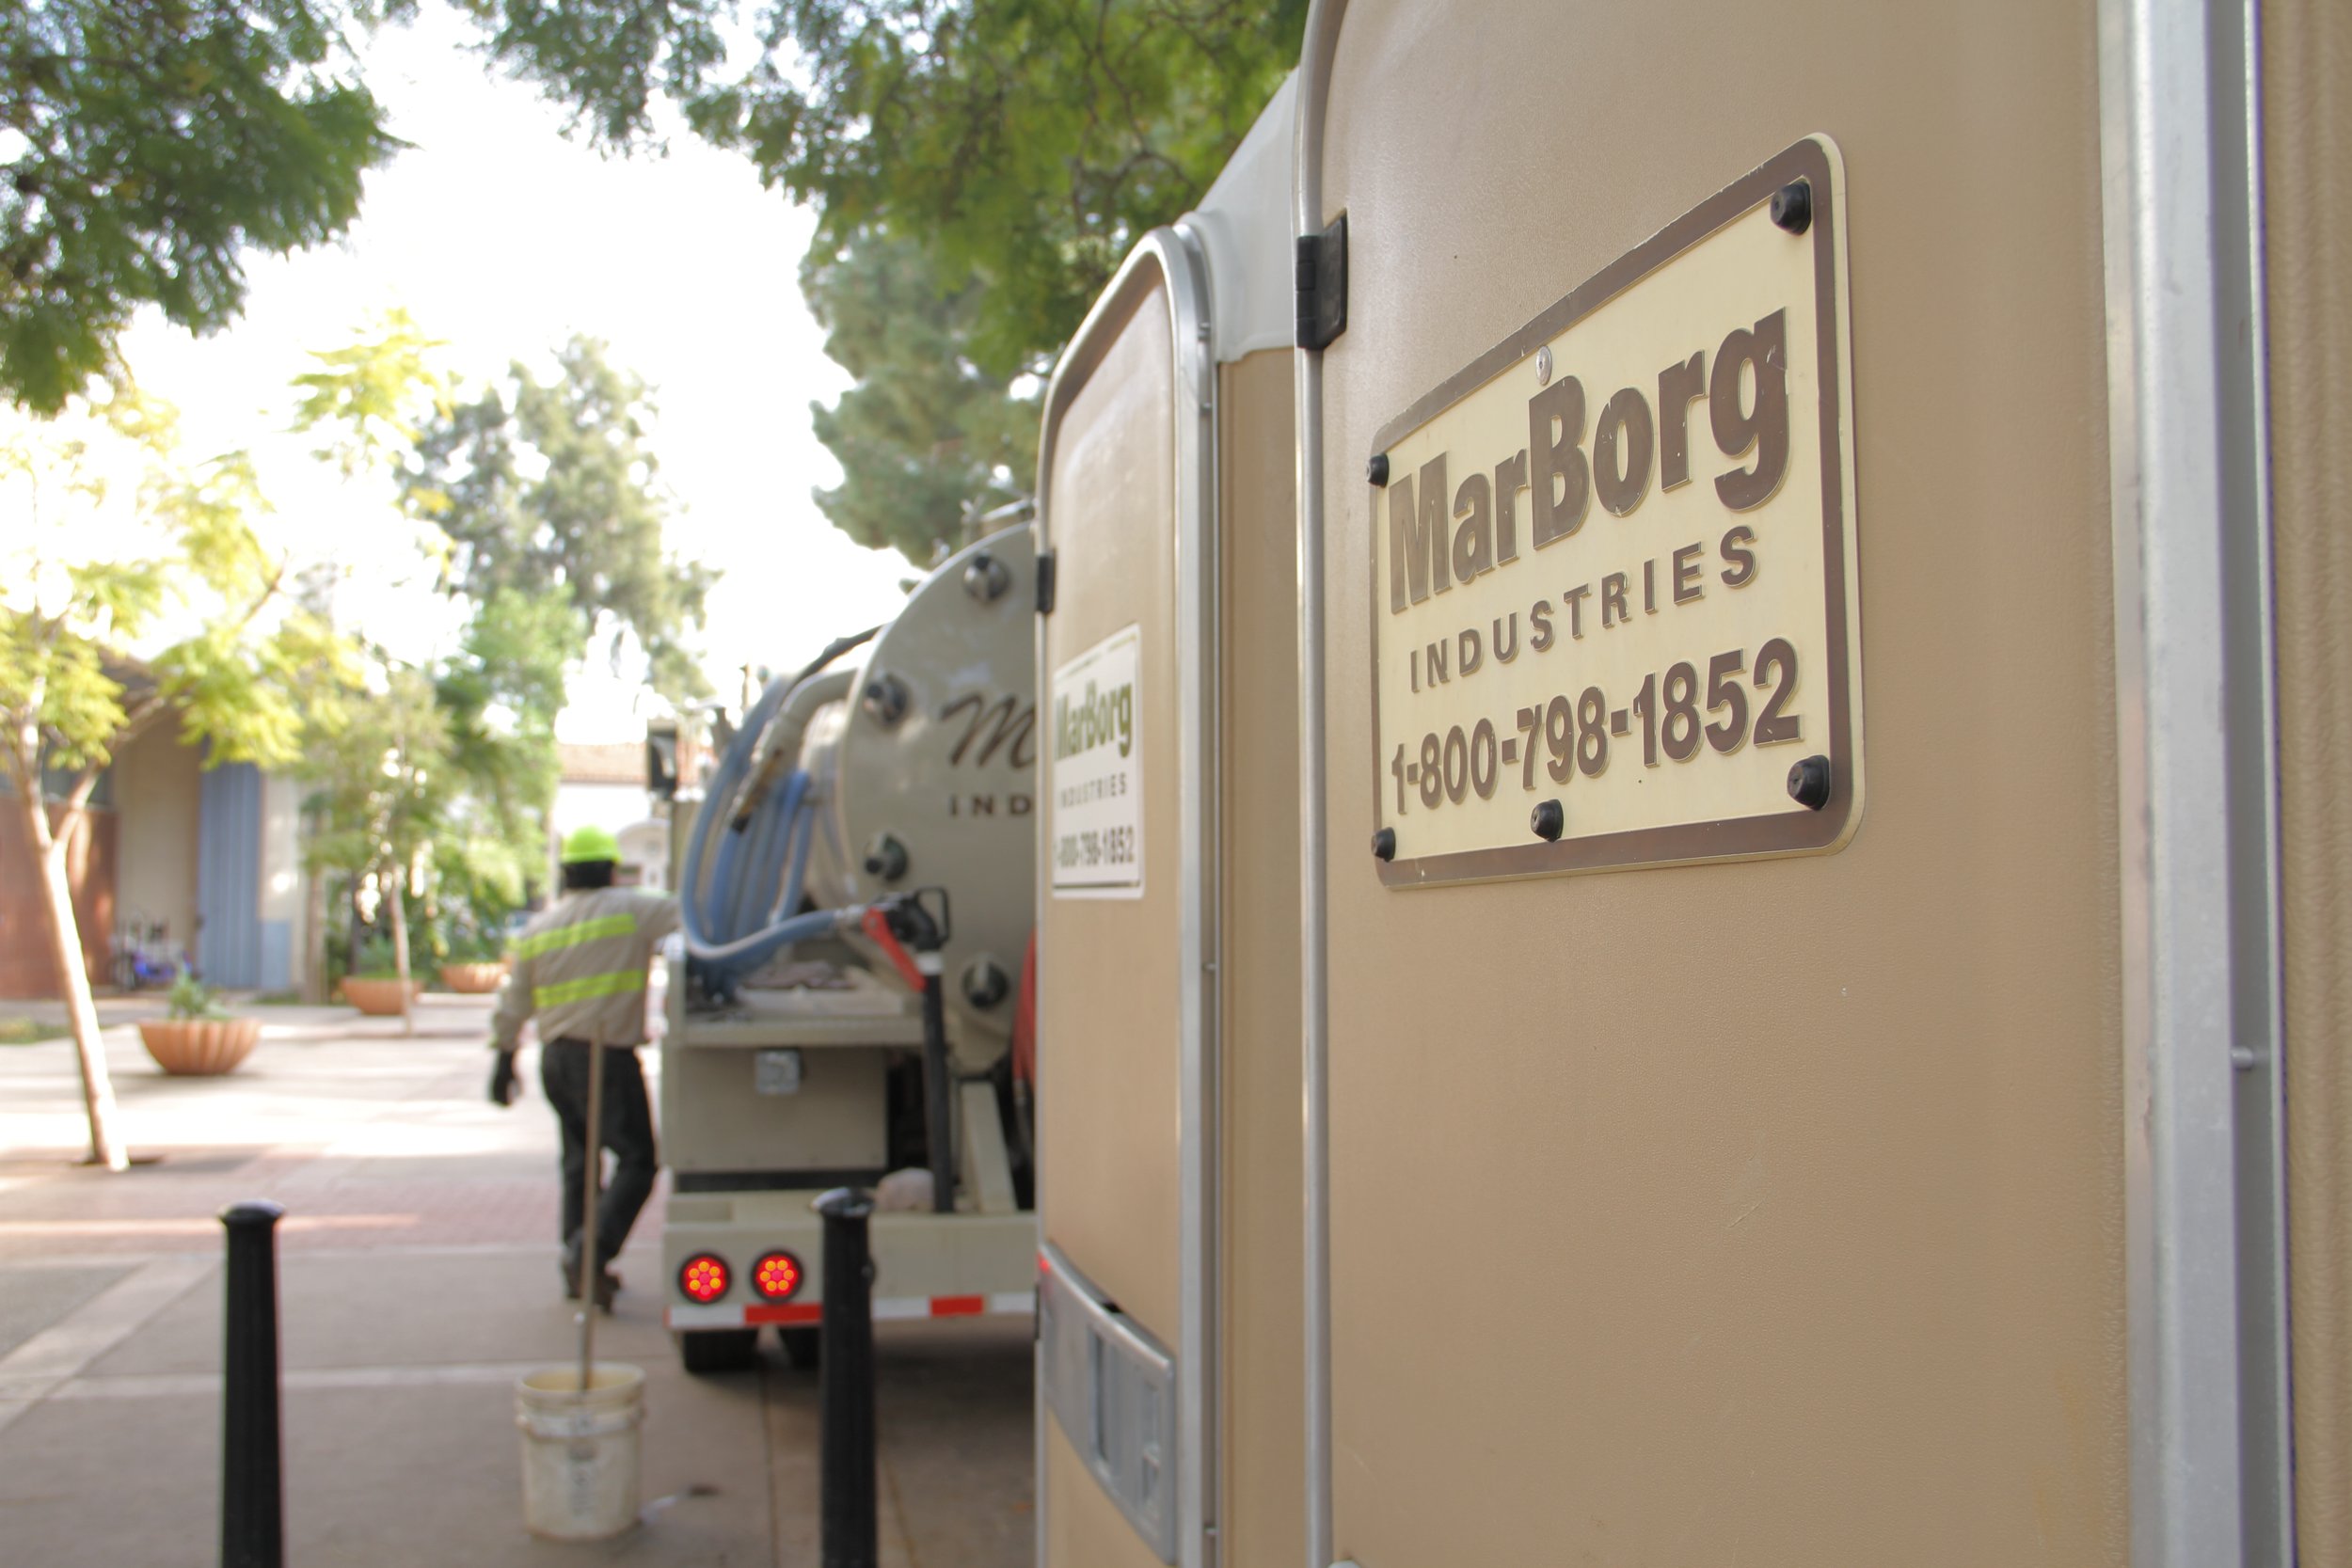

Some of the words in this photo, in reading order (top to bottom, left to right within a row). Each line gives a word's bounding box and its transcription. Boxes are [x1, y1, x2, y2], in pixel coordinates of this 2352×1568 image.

[1389, 308, 1789, 614] MarBorg
[1410, 525, 1757, 693] INDUSTRIES
[1391, 637, 1804, 815] 1-800-798-1852
